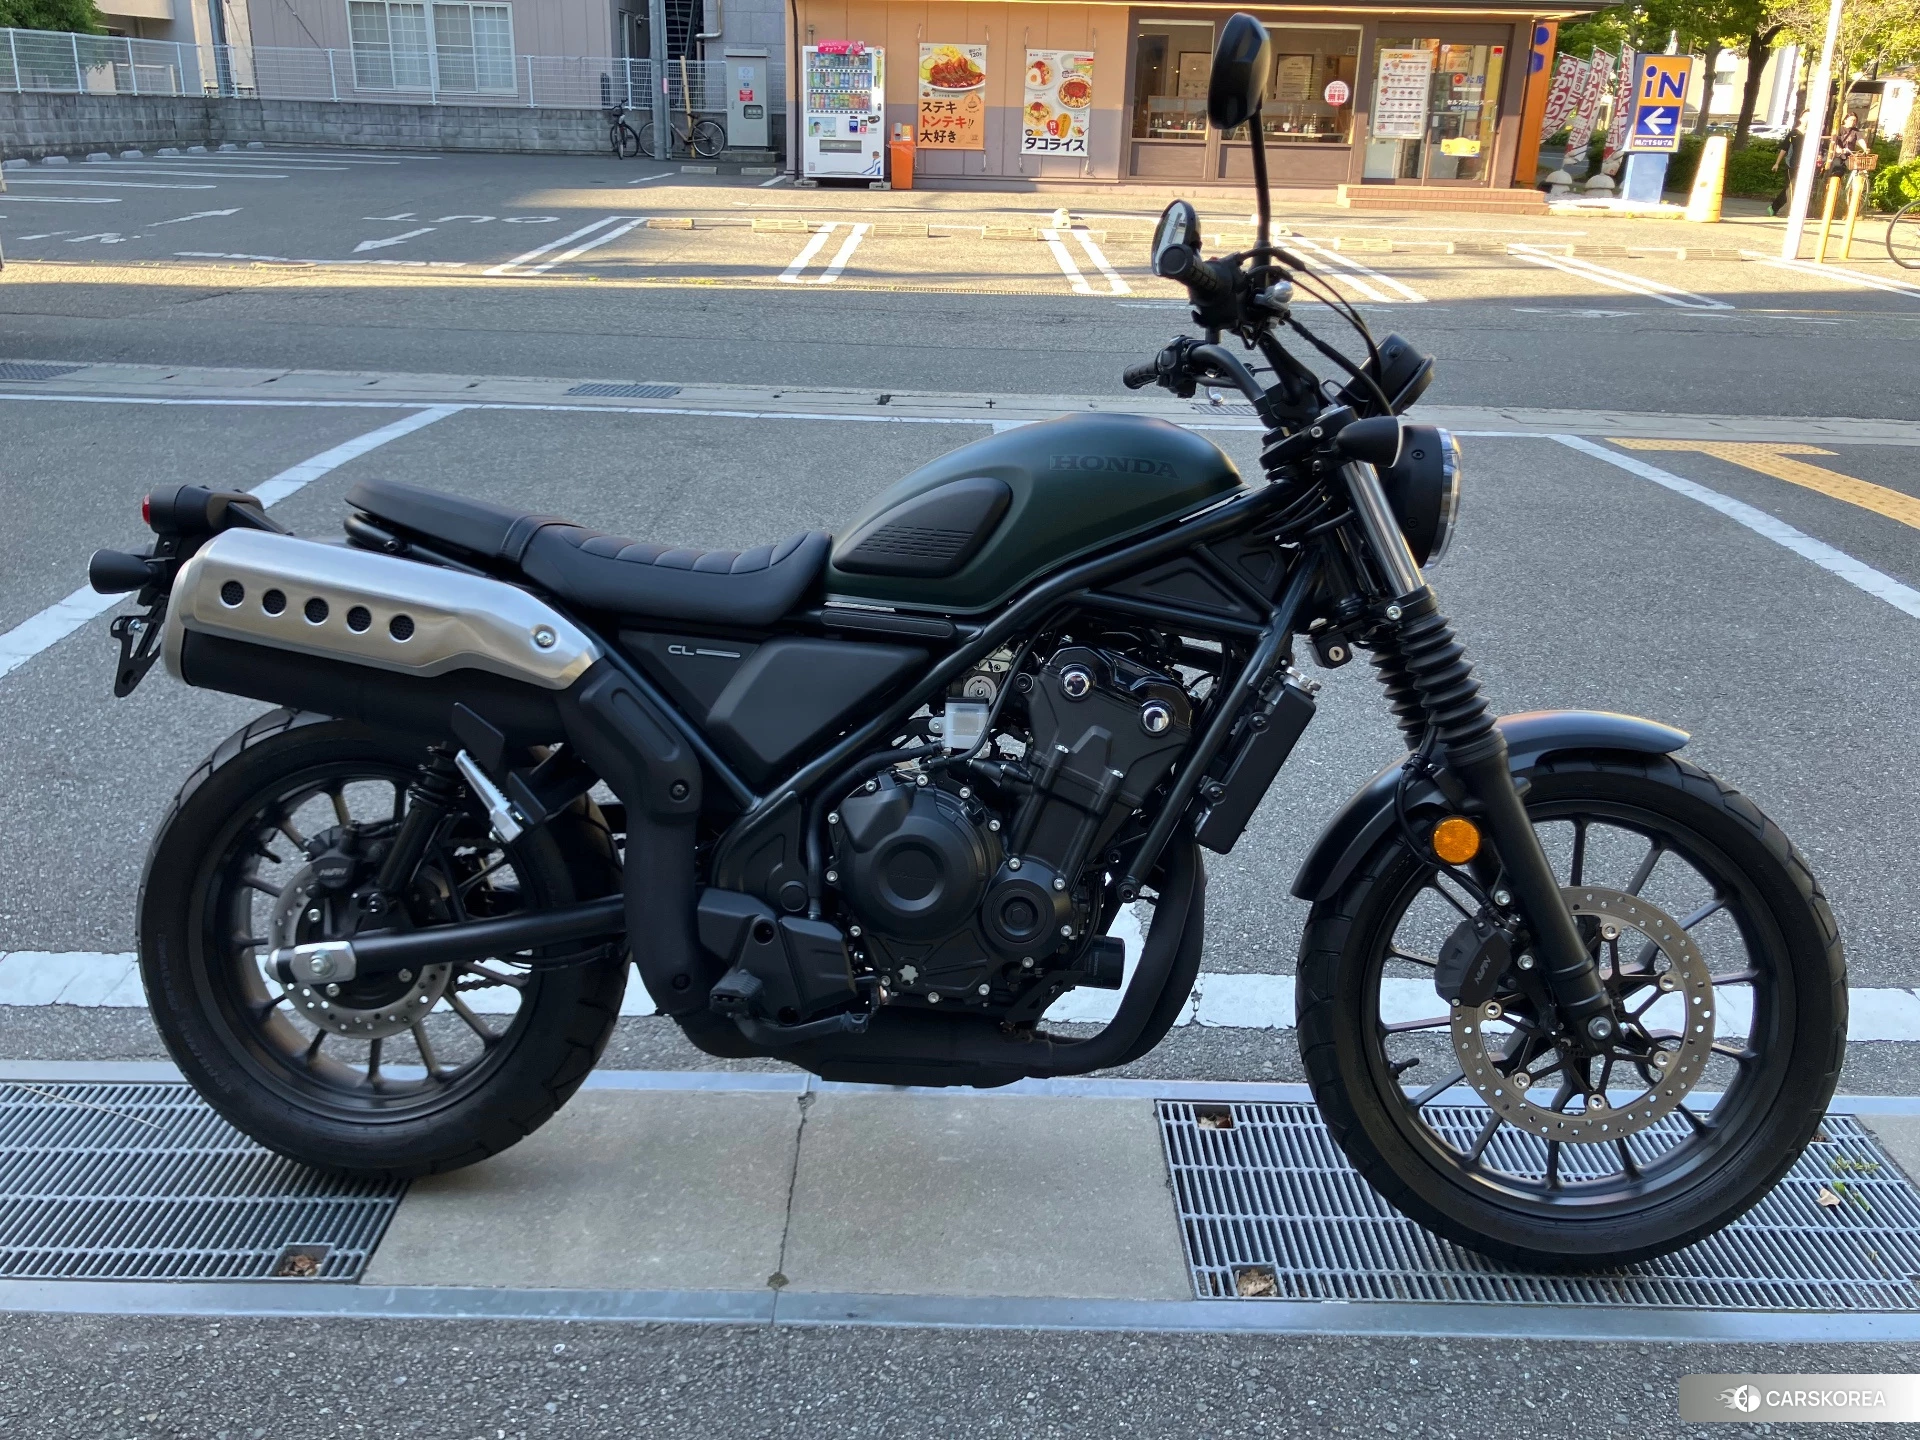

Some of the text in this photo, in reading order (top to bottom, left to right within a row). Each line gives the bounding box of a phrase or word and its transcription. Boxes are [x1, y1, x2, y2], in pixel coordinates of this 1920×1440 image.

[1327, 93, 1345, 101] 無料
[921, 101, 957, 114] ステキ
[1049, 121, 1057, 135] 旨い
[919, 129, 957, 143] 大好き
[1024, 137, 1085, 152] タコライス
[1051, 455, 1181, 480] HONDA
[667, 644, 695, 656] CL
